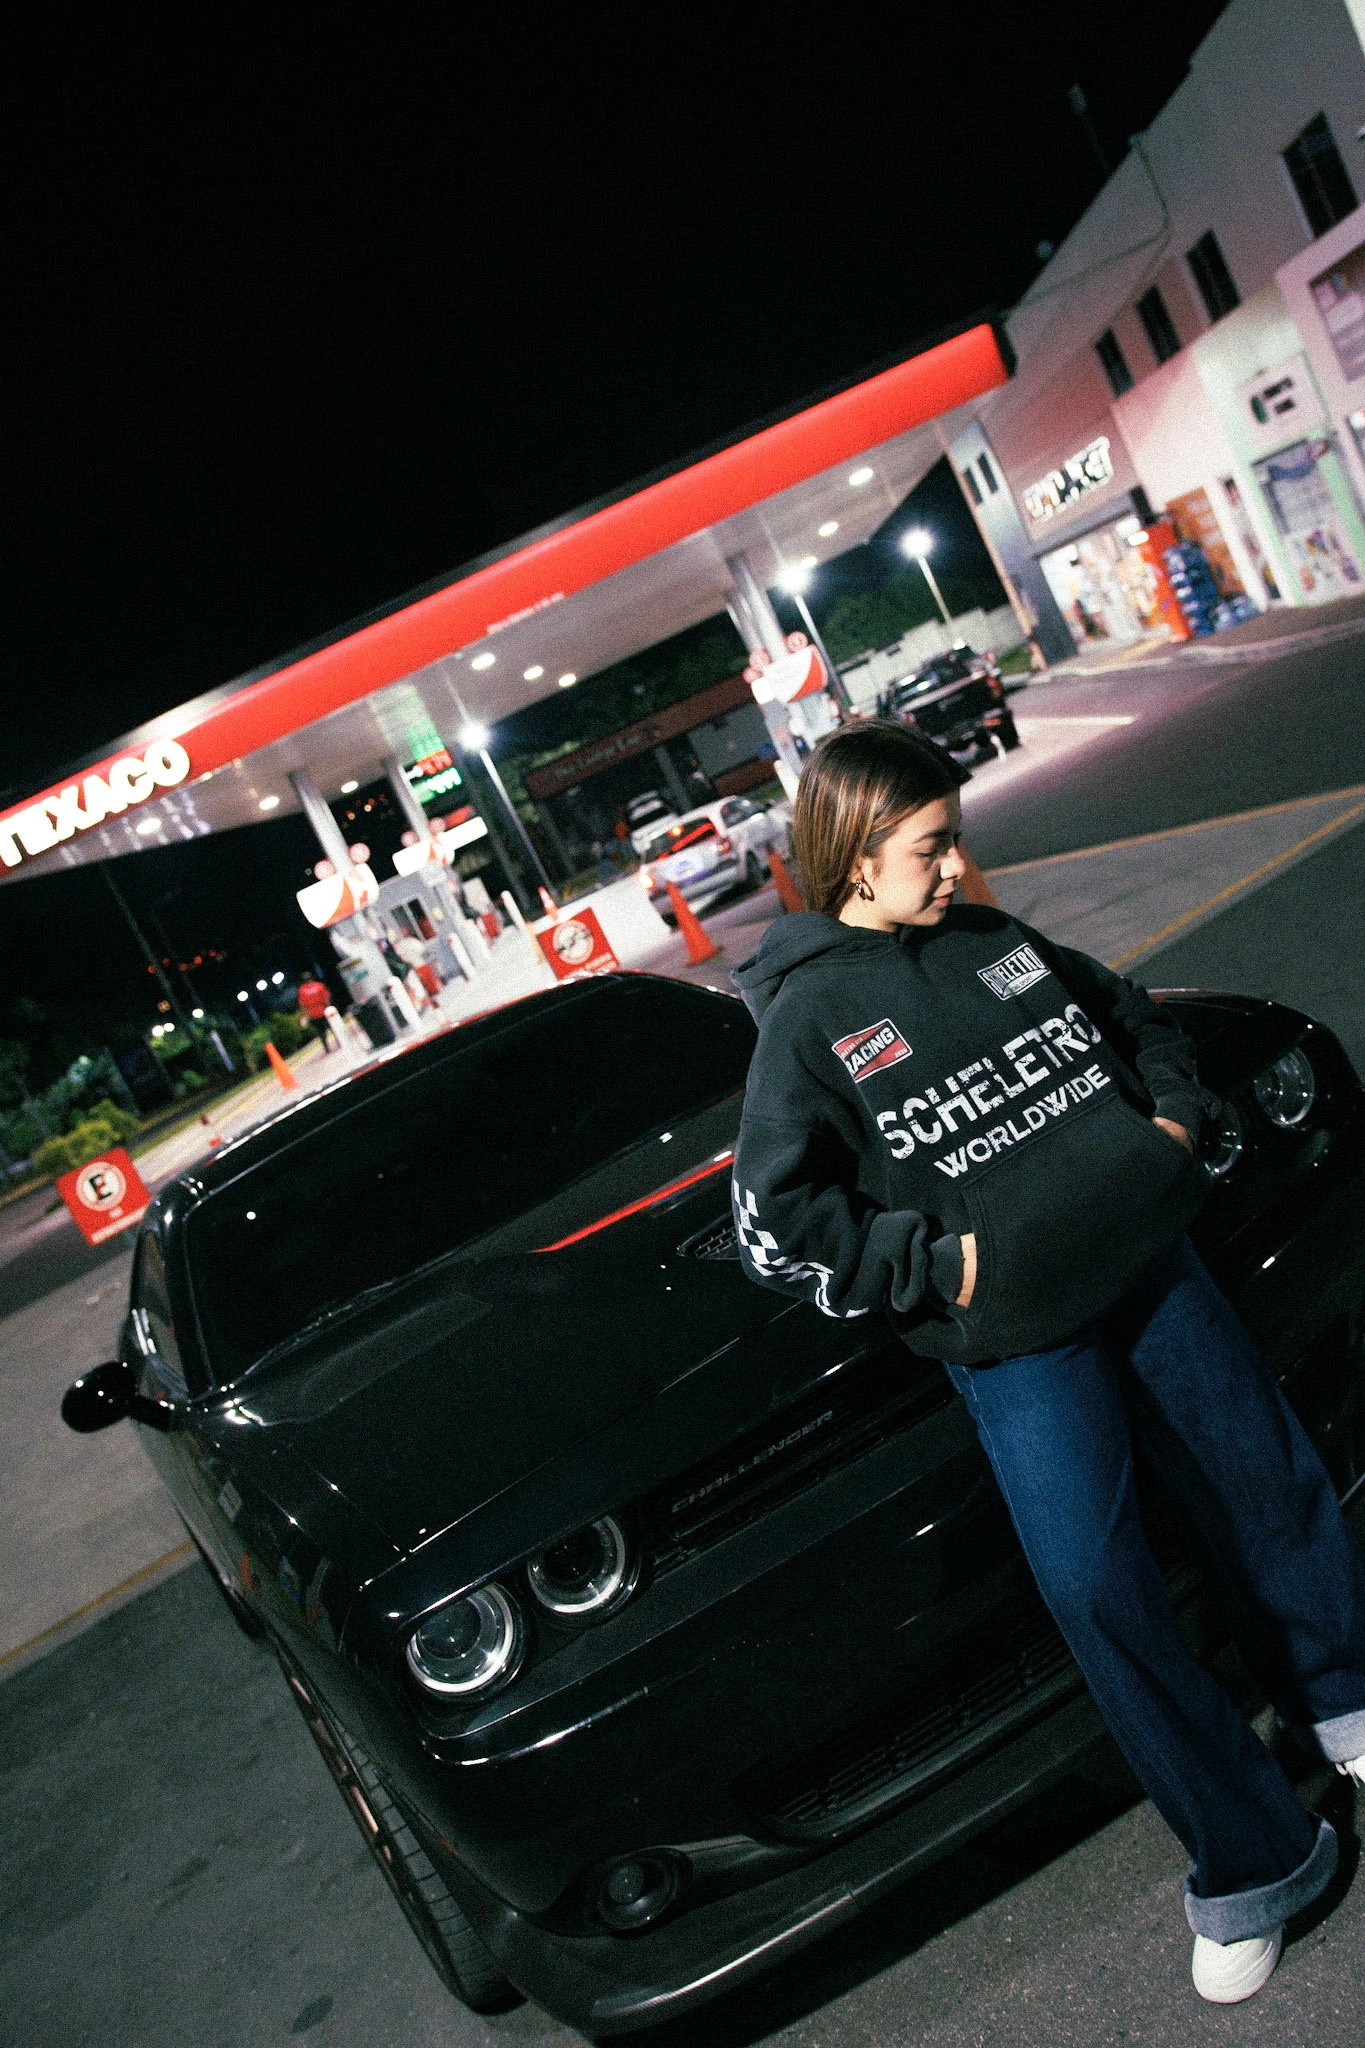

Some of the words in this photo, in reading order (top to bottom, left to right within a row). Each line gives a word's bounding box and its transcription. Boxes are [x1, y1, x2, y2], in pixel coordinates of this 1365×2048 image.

[876, 1003, 1102, 1160] SCHELETRO
[933, 1063, 1111, 1179] WORLDWIDE
[88, 1173, 113, 1201] E
